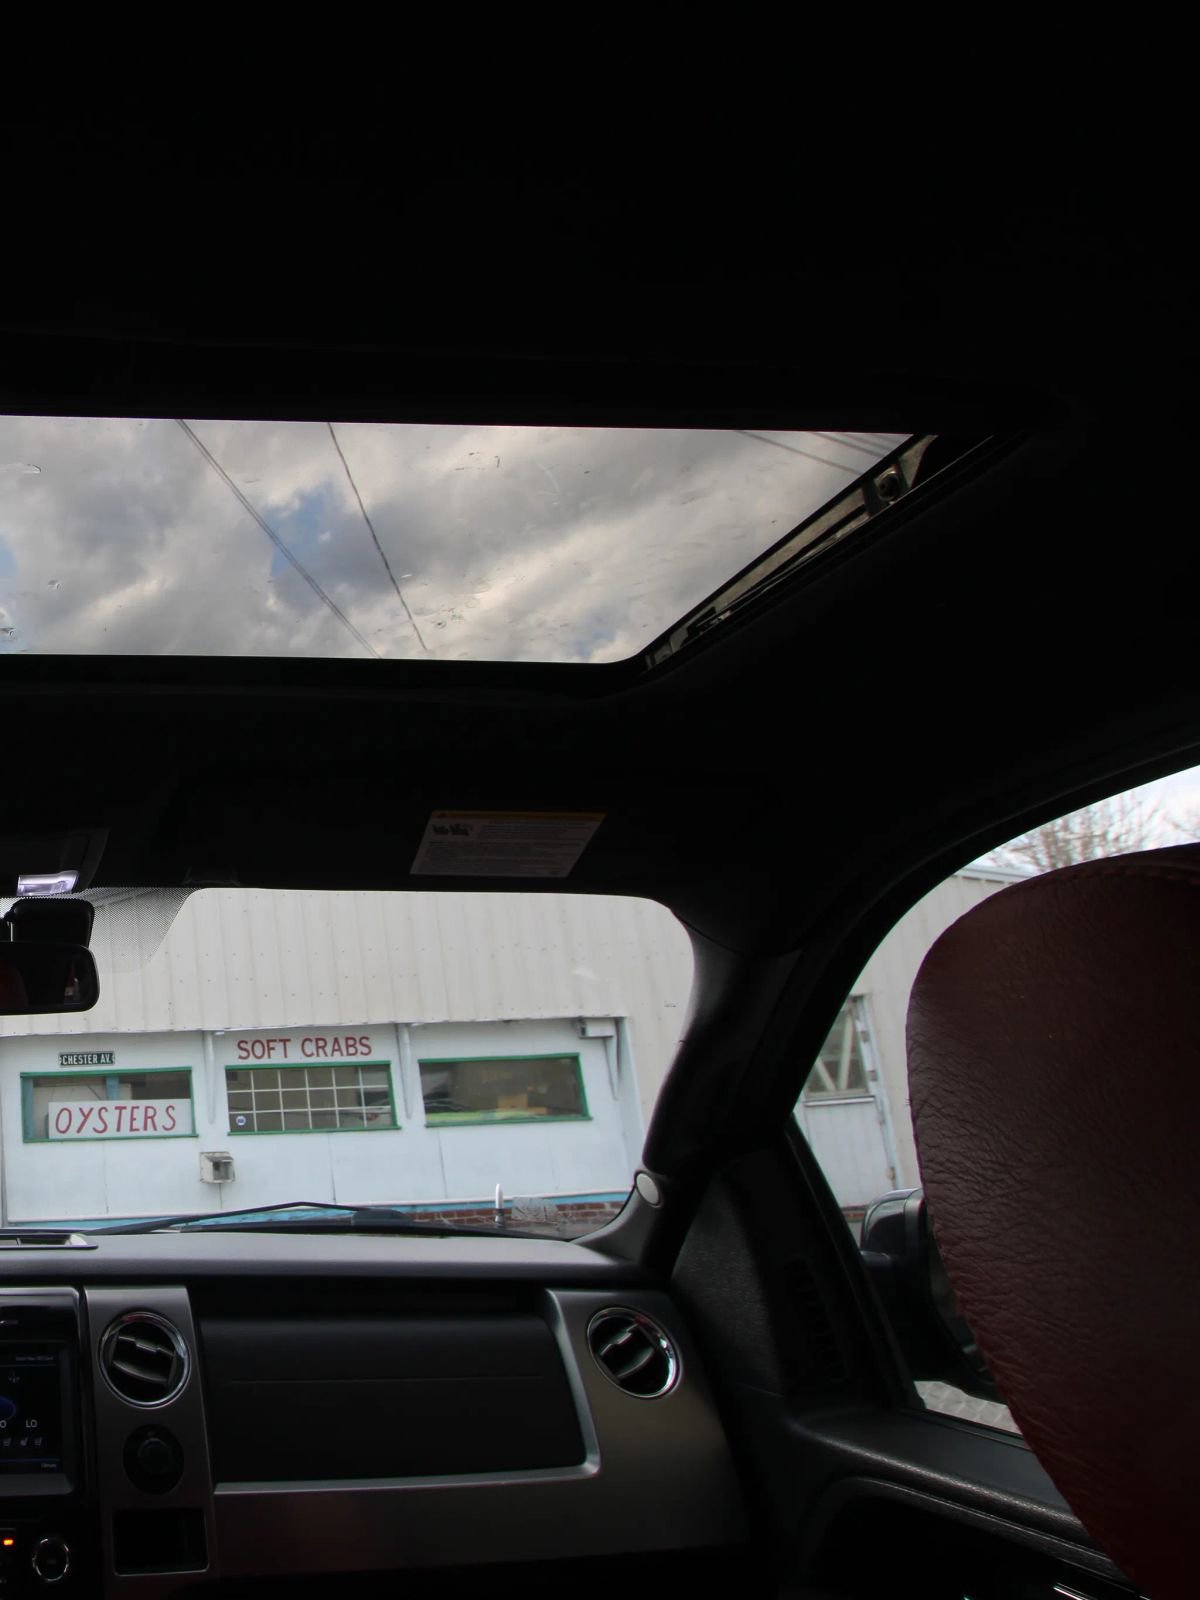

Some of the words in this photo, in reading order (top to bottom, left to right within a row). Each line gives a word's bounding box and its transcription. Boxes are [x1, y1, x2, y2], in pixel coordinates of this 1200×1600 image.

[237, 1038, 291, 1060] SOFT
[301, 1036, 372, 1058] CRABS
[62, 1054, 98, 1065] CHESTER
[55, 1104, 176, 1135] OYSTERS
[25, 1418, 39, 1429] LO
